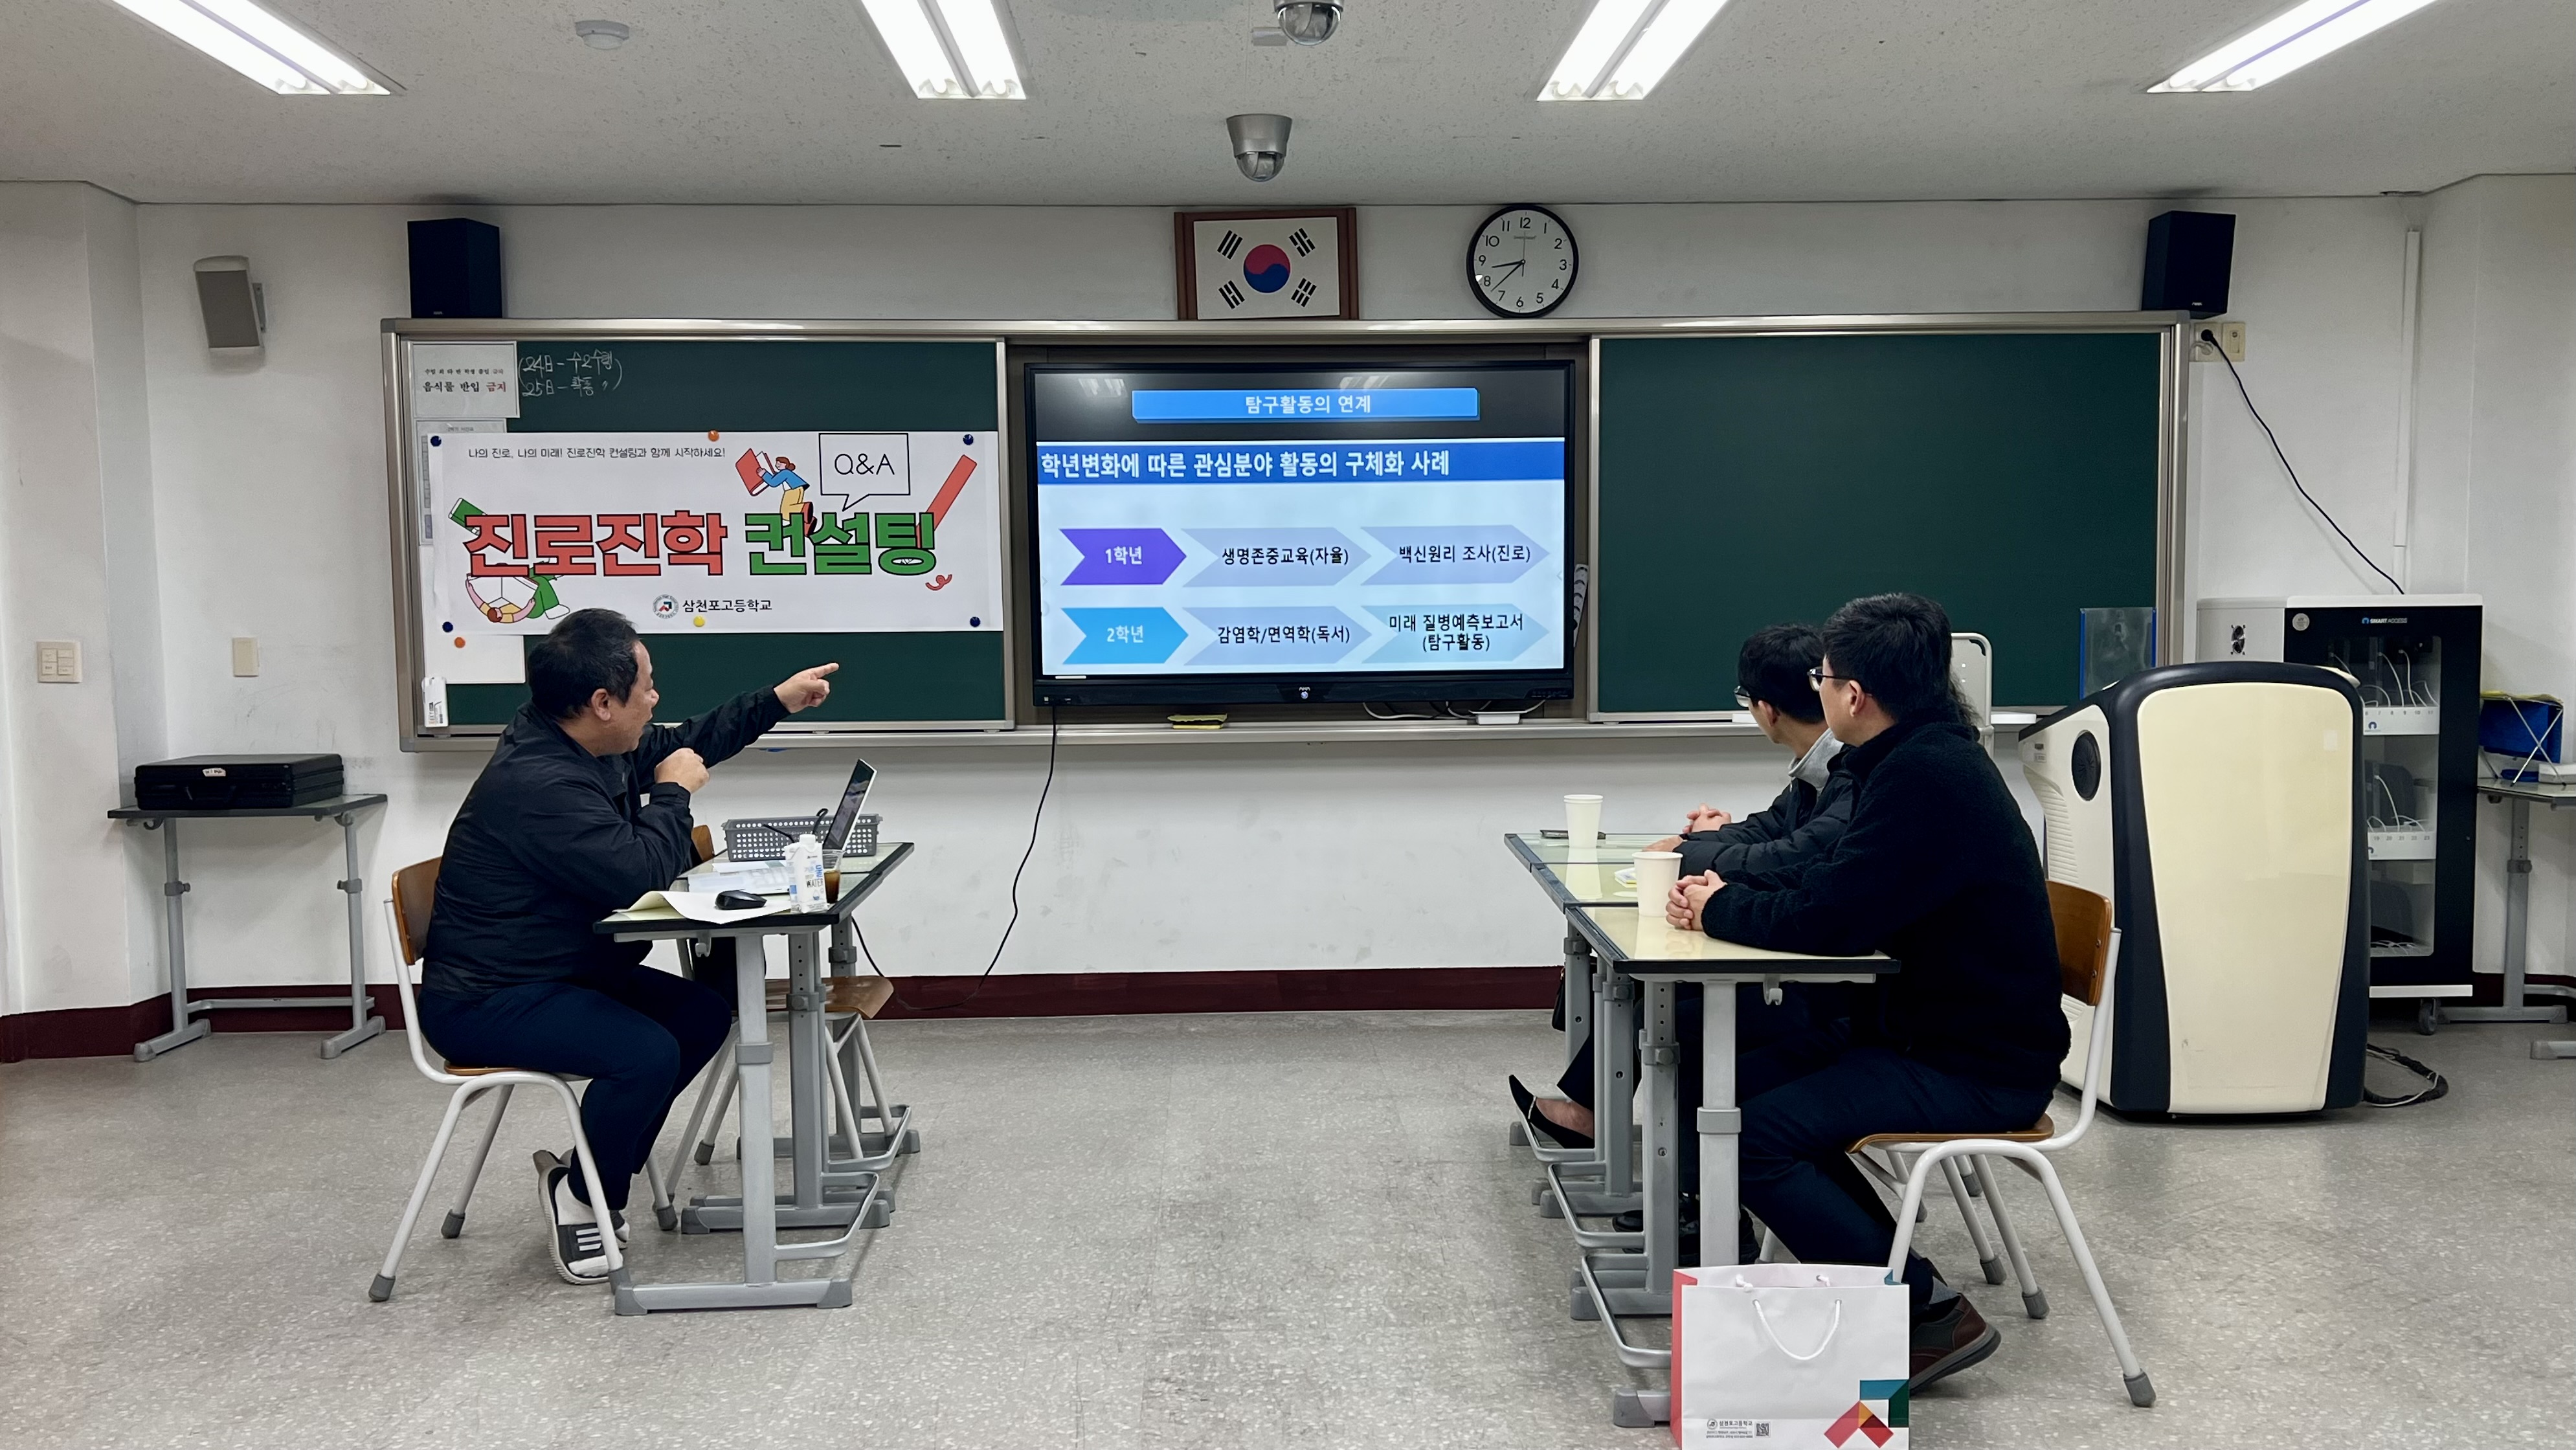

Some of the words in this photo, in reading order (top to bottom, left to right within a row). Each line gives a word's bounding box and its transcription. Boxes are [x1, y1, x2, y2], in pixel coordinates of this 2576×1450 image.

[1502, 220, 1510, 232] 11
[1519, 217, 1531, 229] 12
[1485, 235, 1500, 247] 10
[1554, 238, 1562, 250] 2
[1478, 254, 1486, 266] 9
[1559, 259, 1567, 271] 3
[1483, 275, 1491, 287] 8
[1551, 278, 1559, 290] 4
[1497, 290, 1506, 302] 7
[1516, 296, 1524, 307] 6
[1536, 293, 1543, 304] 5
[422, 381, 455, 393] 음식물
[460, 381, 480, 393] 반입
[486, 381, 506, 392] 금지
[1245, 395, 1330, 414] 탐구활동의
[1338, 395, 1371, 413] 연계
[468, 448, 488, 458] 나의
[491, 448, 513, 460] 진로,
[517, 448, 537, 458] 나의
[541, 448, 563, 458] 미래!
[566, 448, 605, 458] 진로진학
[609, 448, 647, 458] 컨설팅과
[651, 448, 671, 458] 함께
[675, 447, 726, 458] 시작하세요!
[834, 452, 895, 476] Q&A
[1041, 452, 1139, 478] 학년변화에
[1148, 453, 1187, 478] 따른
[1194, 452, 1273, 477] 관심분야
[1279, 451, 1337, 476] 활동의
[1345, 451, 1405, 476] 구체화
[1411, 450, 1449, 476] 사례
[464, 510, 728, 577] 진로진학
[745, 511, 937, 576] 컨설팅
[1104, 547, 1143, 565] 1학년
[1222, 546, 1349, 566] 생명존중교육(자율)
[1399, 545, 1455, 564] 백신원리
[1462, 544, 1530, 563] 조사(진로)
[682, 599, 772, 613] 삼천포고등학교
[1389, 614, 1416, 632] 미래
[1423, 613, 1523, 632] 질병예측보고서
[1107, 625, 1143, 643] 2학년
[1218, 625, 1350, 644] 감염학/면역학(독서)
[1422, 632, 1490, 652] (탐구활동)
